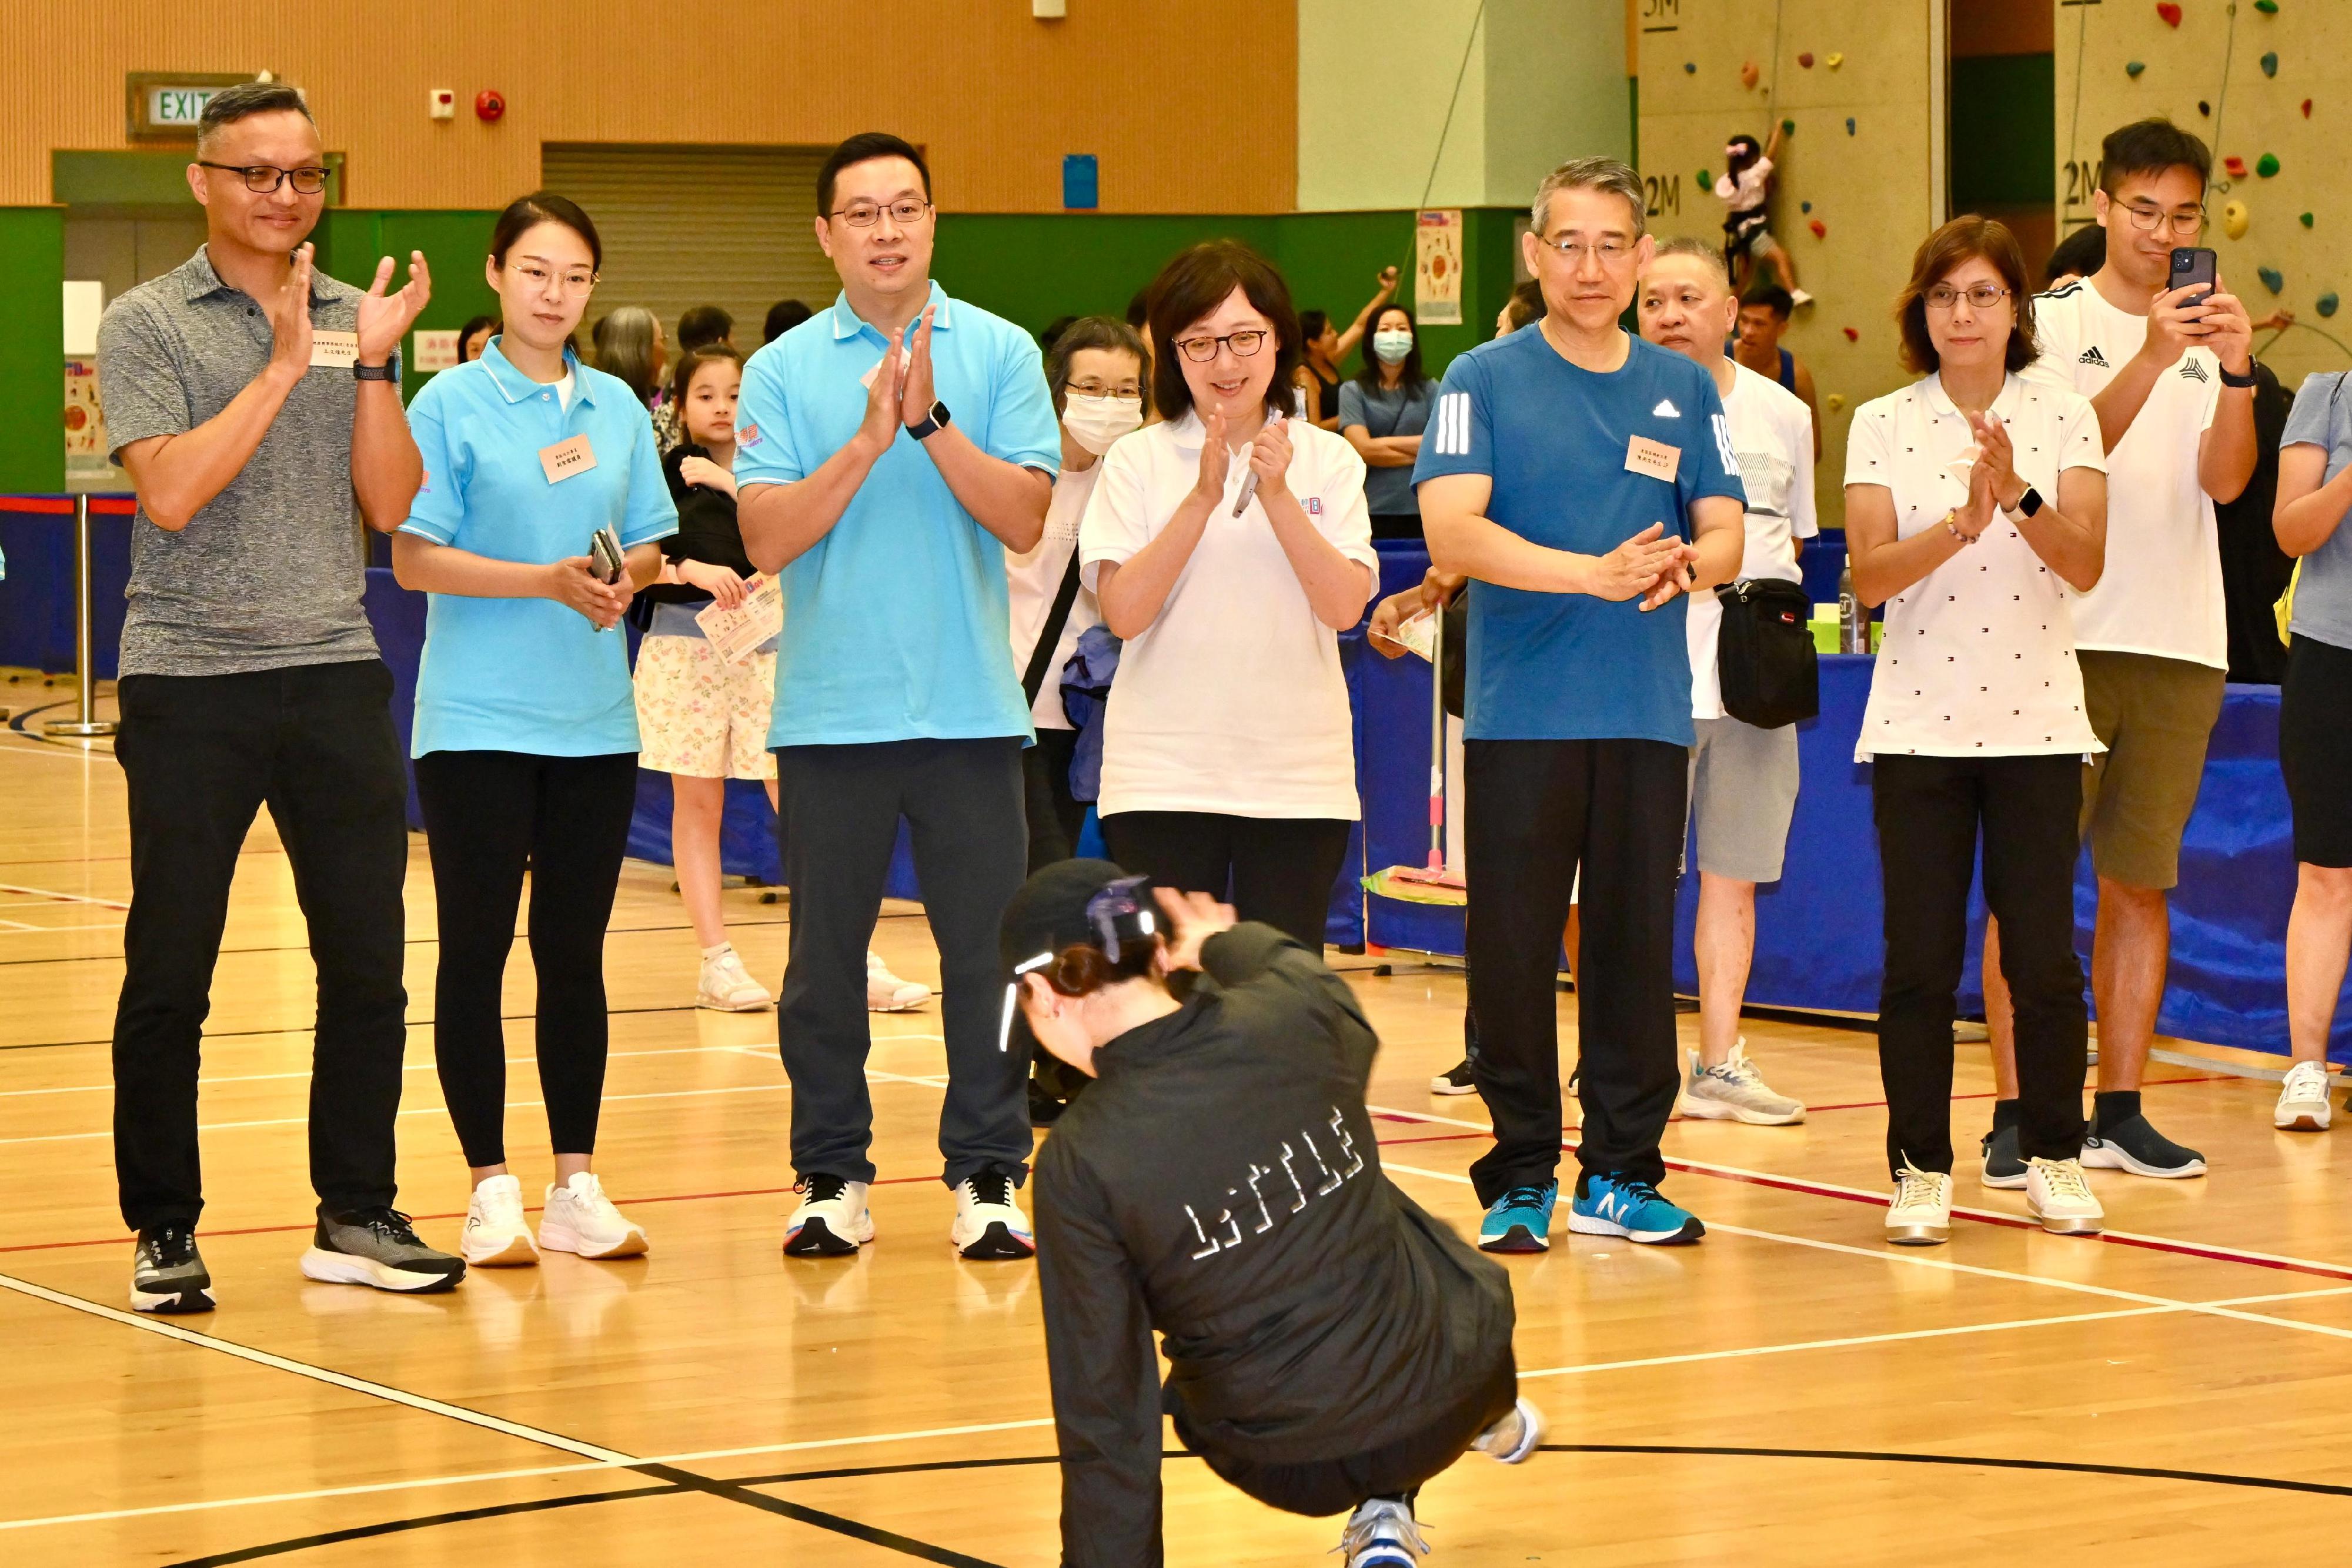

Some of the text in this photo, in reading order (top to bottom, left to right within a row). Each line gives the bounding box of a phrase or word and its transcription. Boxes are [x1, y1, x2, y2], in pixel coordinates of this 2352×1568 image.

[160, 92, 211, 119] EXIT
[1645, 175, 1680, 216] 2M
[2079, 357, 2109, 368] adidas
